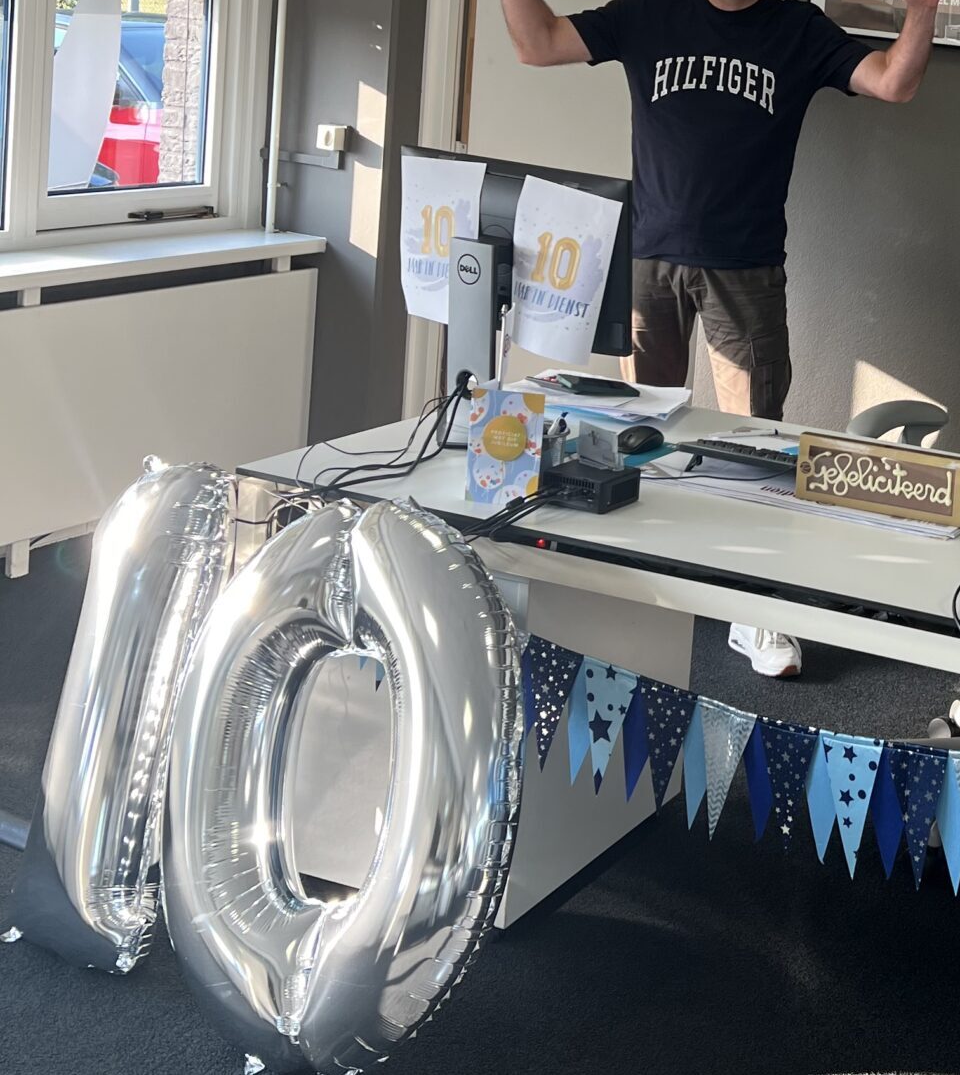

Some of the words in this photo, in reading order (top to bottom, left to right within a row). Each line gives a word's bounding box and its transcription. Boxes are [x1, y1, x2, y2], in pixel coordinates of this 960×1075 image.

[651, 55, 776, 115] HILFIGER
[420, 205, 455, 257] 10
[460, 264, 478, 275] DELL
[529, 231, 580, 291] 10
[532, 288, 546, 305] IN
[548, 293, 590, 318] DIENST
[809, 451, 953, 506] Gefeliciteerd
